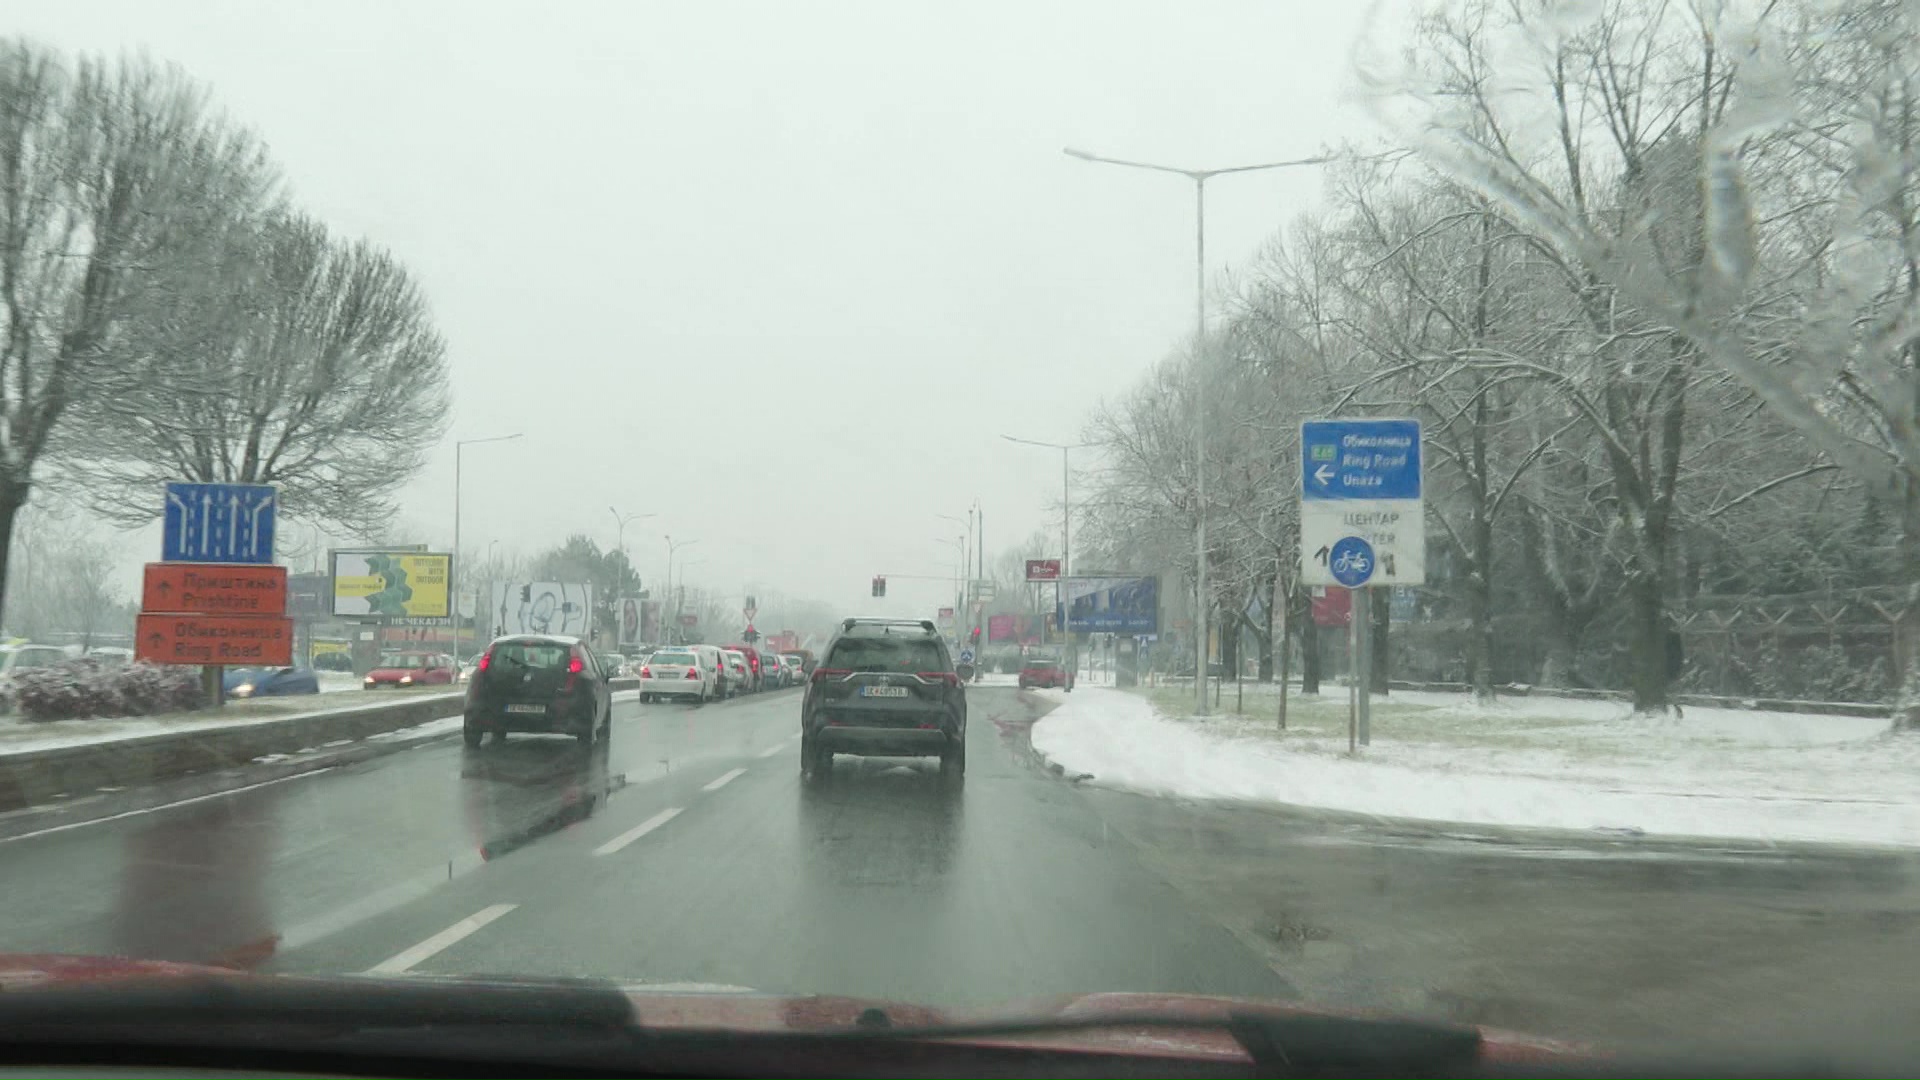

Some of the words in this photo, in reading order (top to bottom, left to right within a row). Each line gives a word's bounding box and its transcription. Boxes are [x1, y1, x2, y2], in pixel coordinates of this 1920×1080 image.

[1342, 454, 1371, 469] Ring
[1374, 452, 1406, 467] Road
[1344, 511, 1400, 525] ЦЕНТАР
[183, 572, 277, 591] Приштина
[175, 642, 211, 660] Ring
[219, 642, 263, 657] Road
